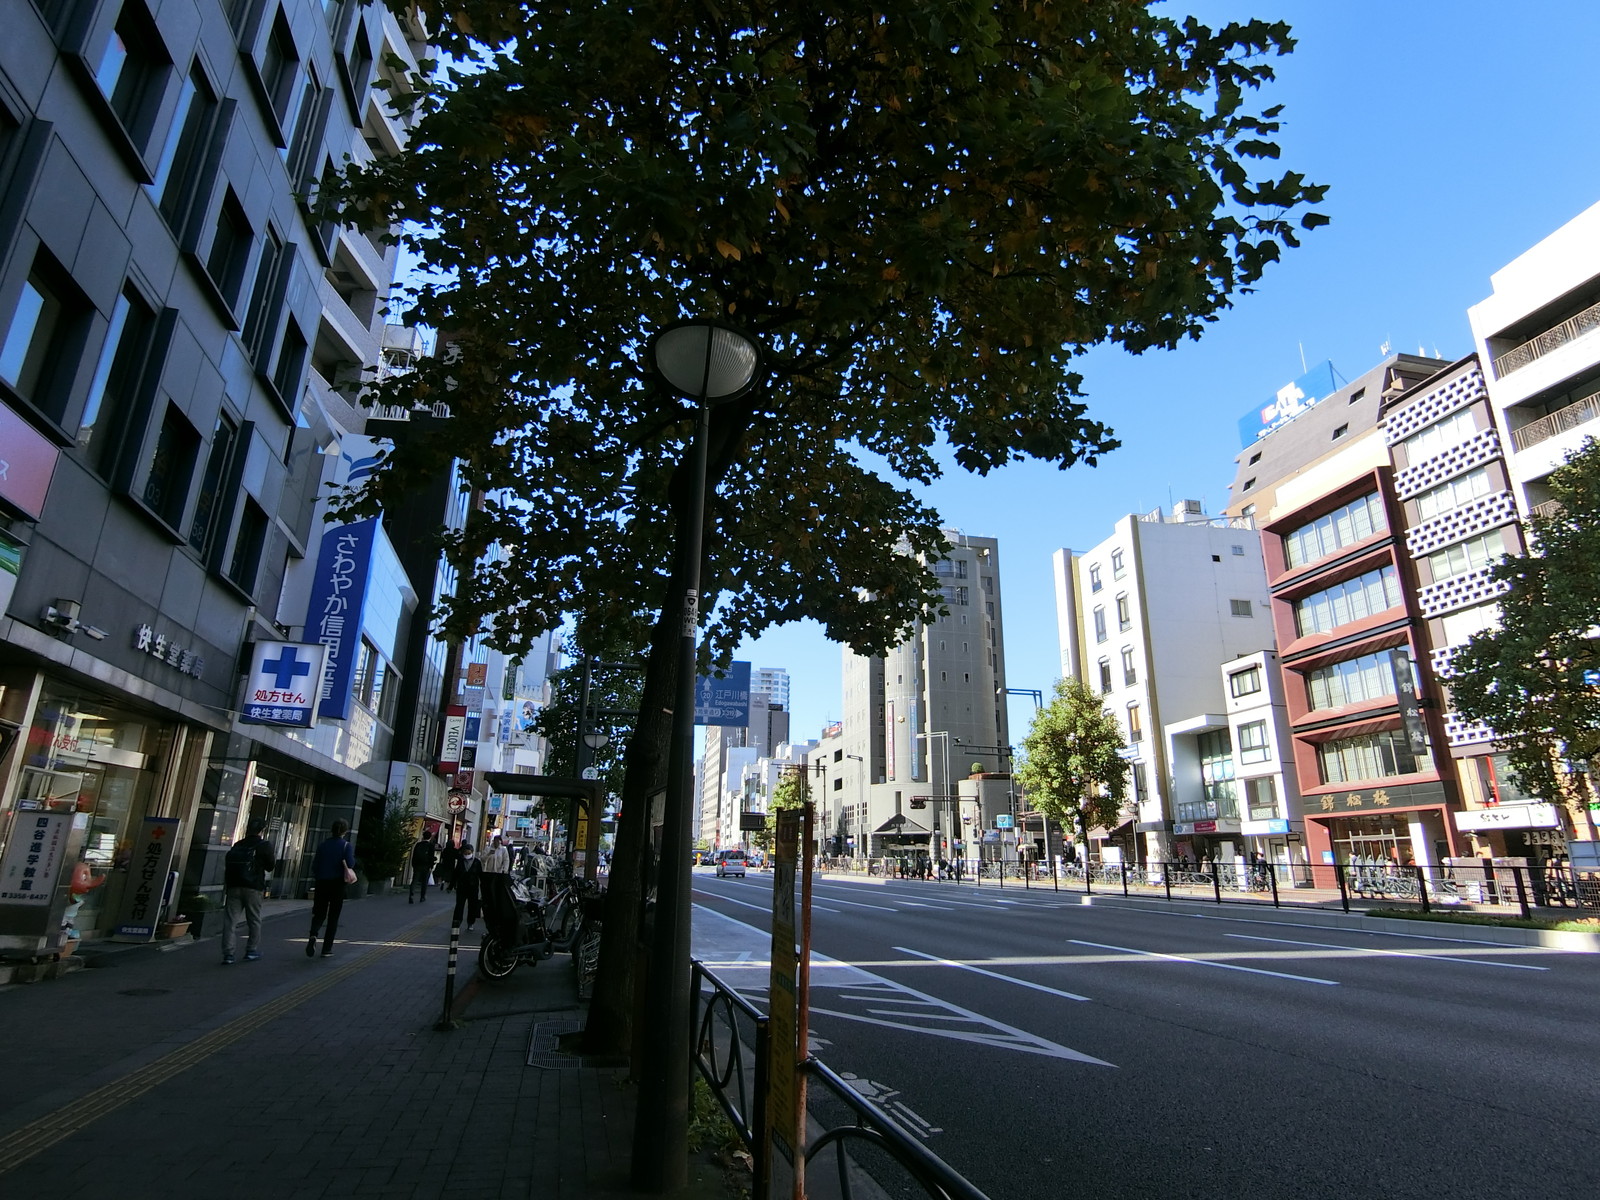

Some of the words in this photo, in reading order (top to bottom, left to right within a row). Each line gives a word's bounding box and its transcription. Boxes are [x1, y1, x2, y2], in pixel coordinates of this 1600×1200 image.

[146, 482, 162, 506] 03
[191, 522, 205, 542] 58
[136, 622, 206, 680] 快生堂薬局
[254, 689, 306, 704] 処方せん
[715, 689, 748, 700] 江戸川橋
[715, 699, 748, 707] Edogawabashi
[250, 706, 303, 722] 快生堂薬局
[1400, 682, 1424, 743] 錦松梅
[446, 725, 460, 751] VELOCE
[408, 775, 422, 808] 不動産
[1320, 789, 1391, 812] 錦松梅
[19, 817, 49, 891] 四谷進学教室
[131, 842, 162, 920] 処方せん受付
